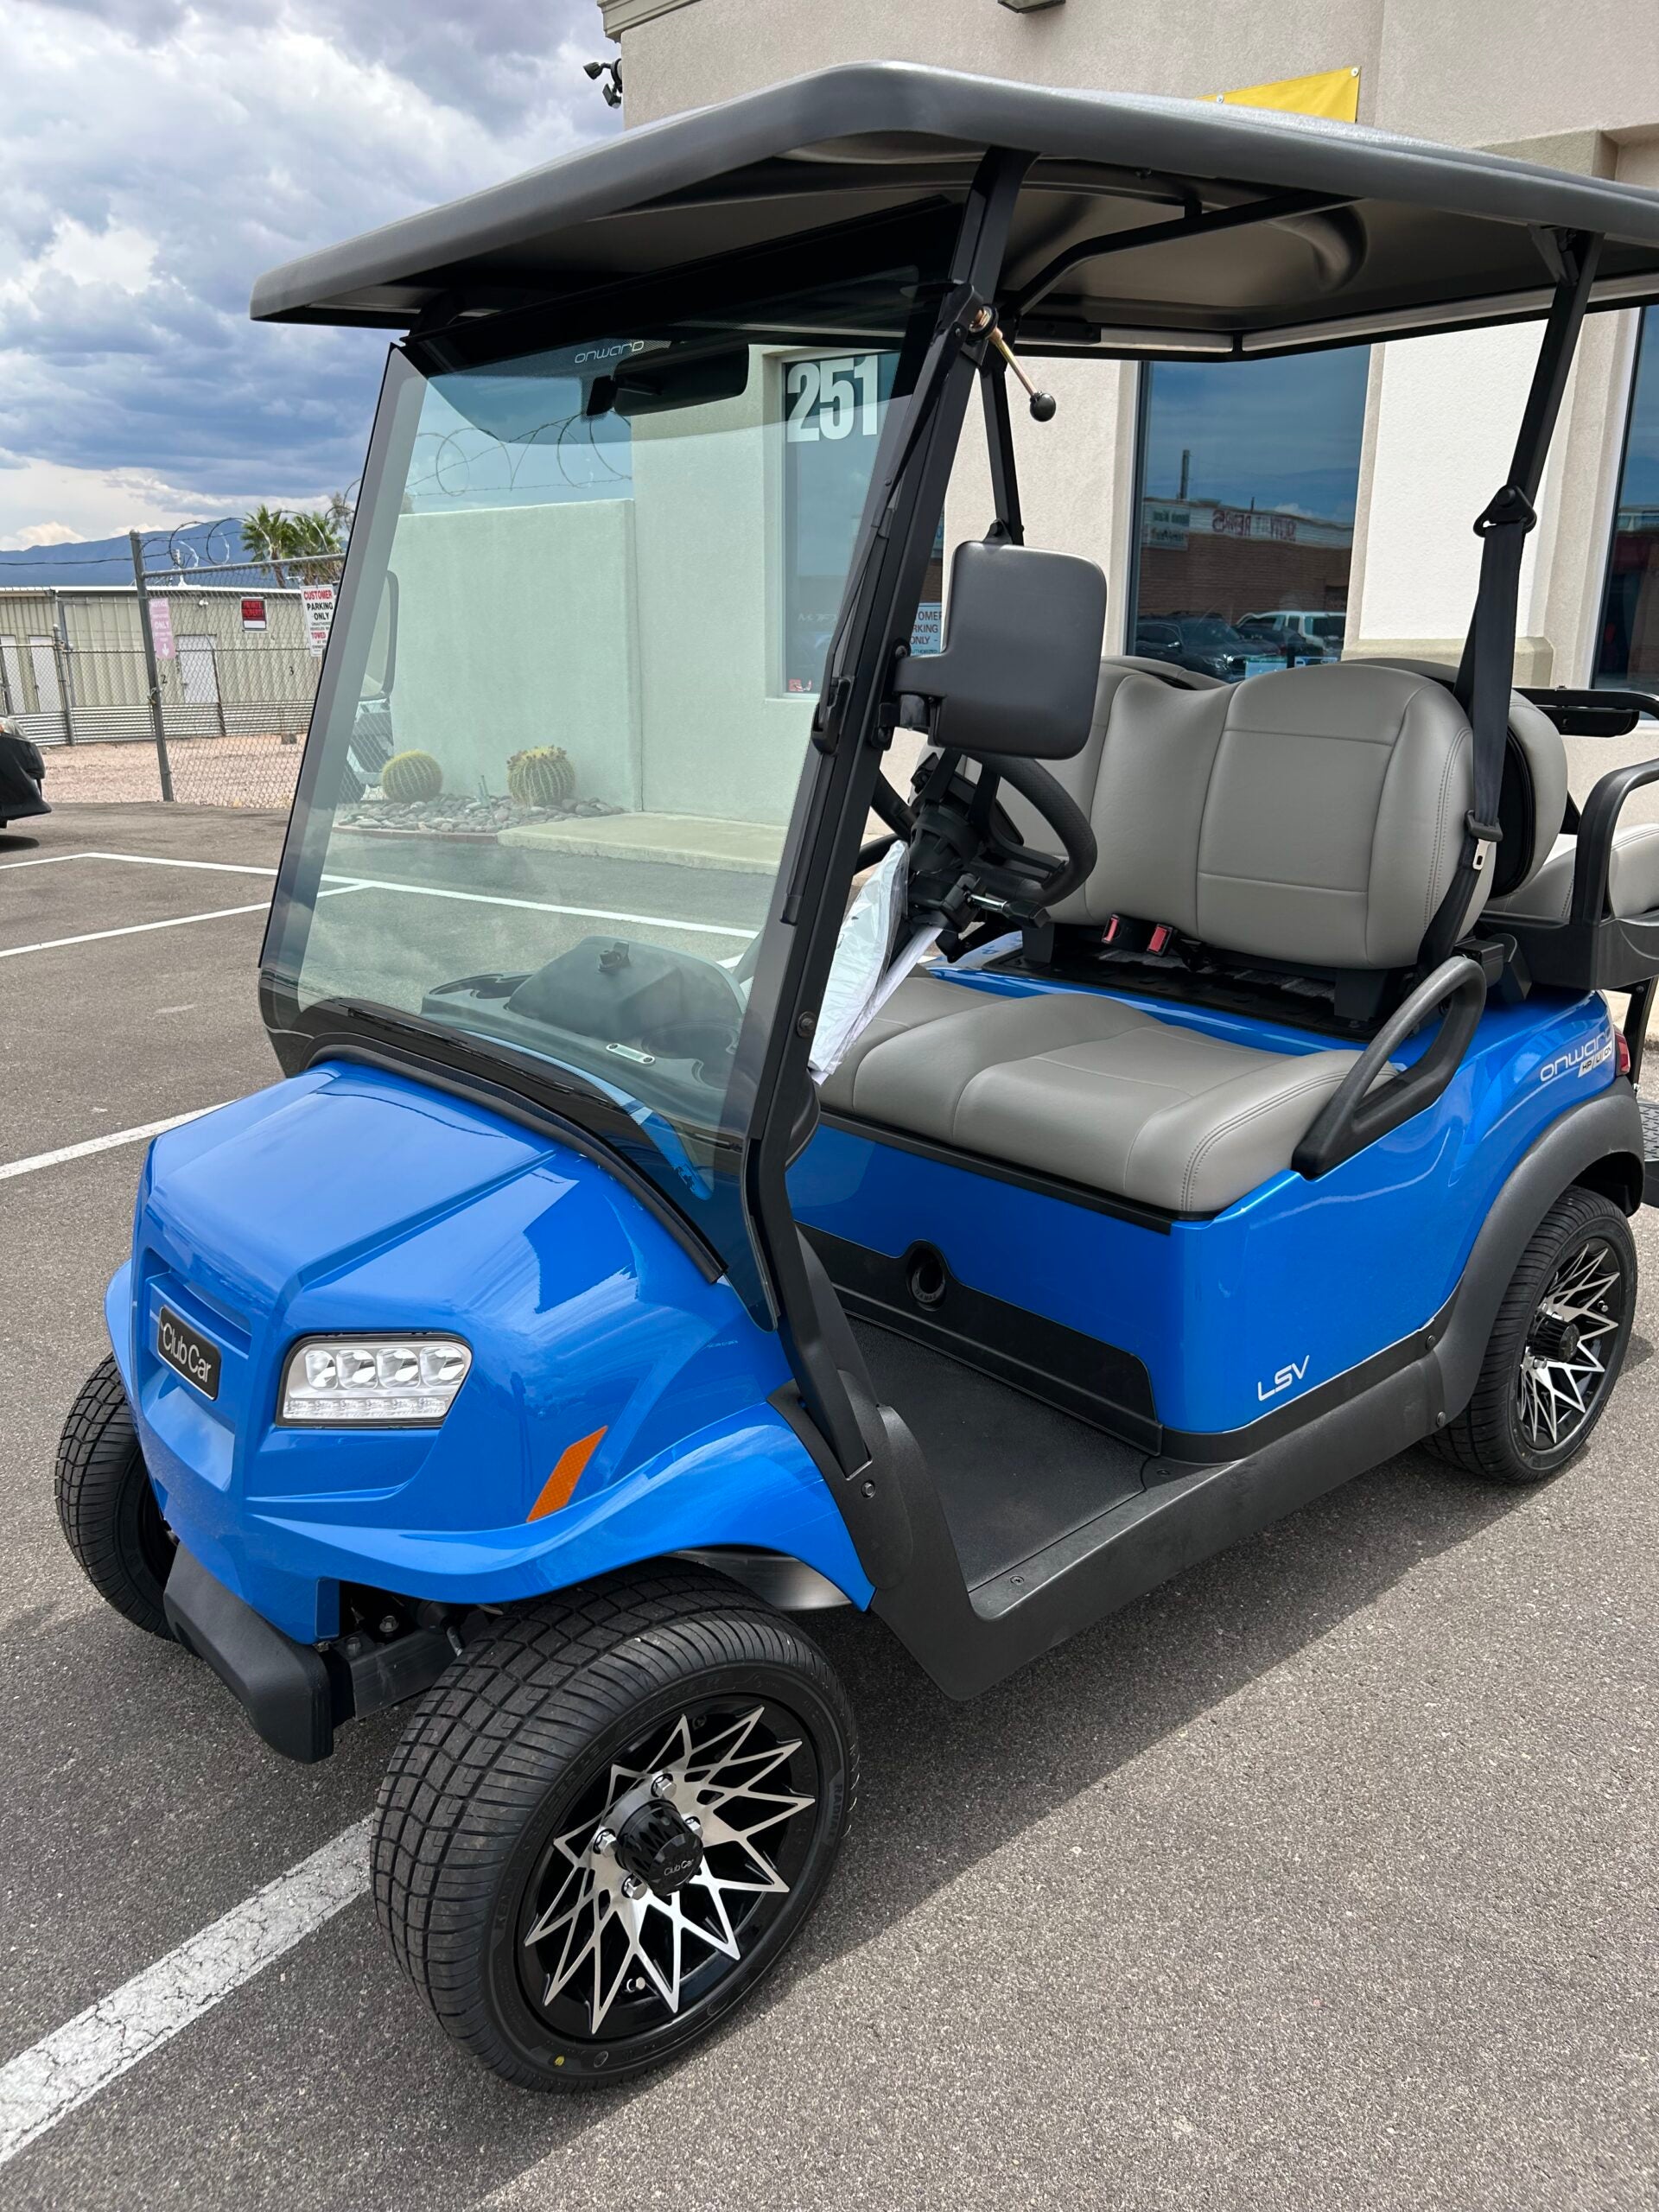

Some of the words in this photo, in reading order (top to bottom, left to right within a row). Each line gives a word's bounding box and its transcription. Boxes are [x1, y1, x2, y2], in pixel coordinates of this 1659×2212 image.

[787, 355, 878, 442] 251
[303, 589, 333, 601] CUSTOMER
[307, 601, 334, 611] PARKING
[314, 612, 329, 620] ONLY
[311, 632, 327, 640] TOWED
[162, 1322, 188, 1365] Club
[188, 1344, 213, 1382] Car
[1257, 1354, 1310, 1402] LSV
[664, 1864, 681, 1876] Club
[681, 1859, 695, 1869] Car
